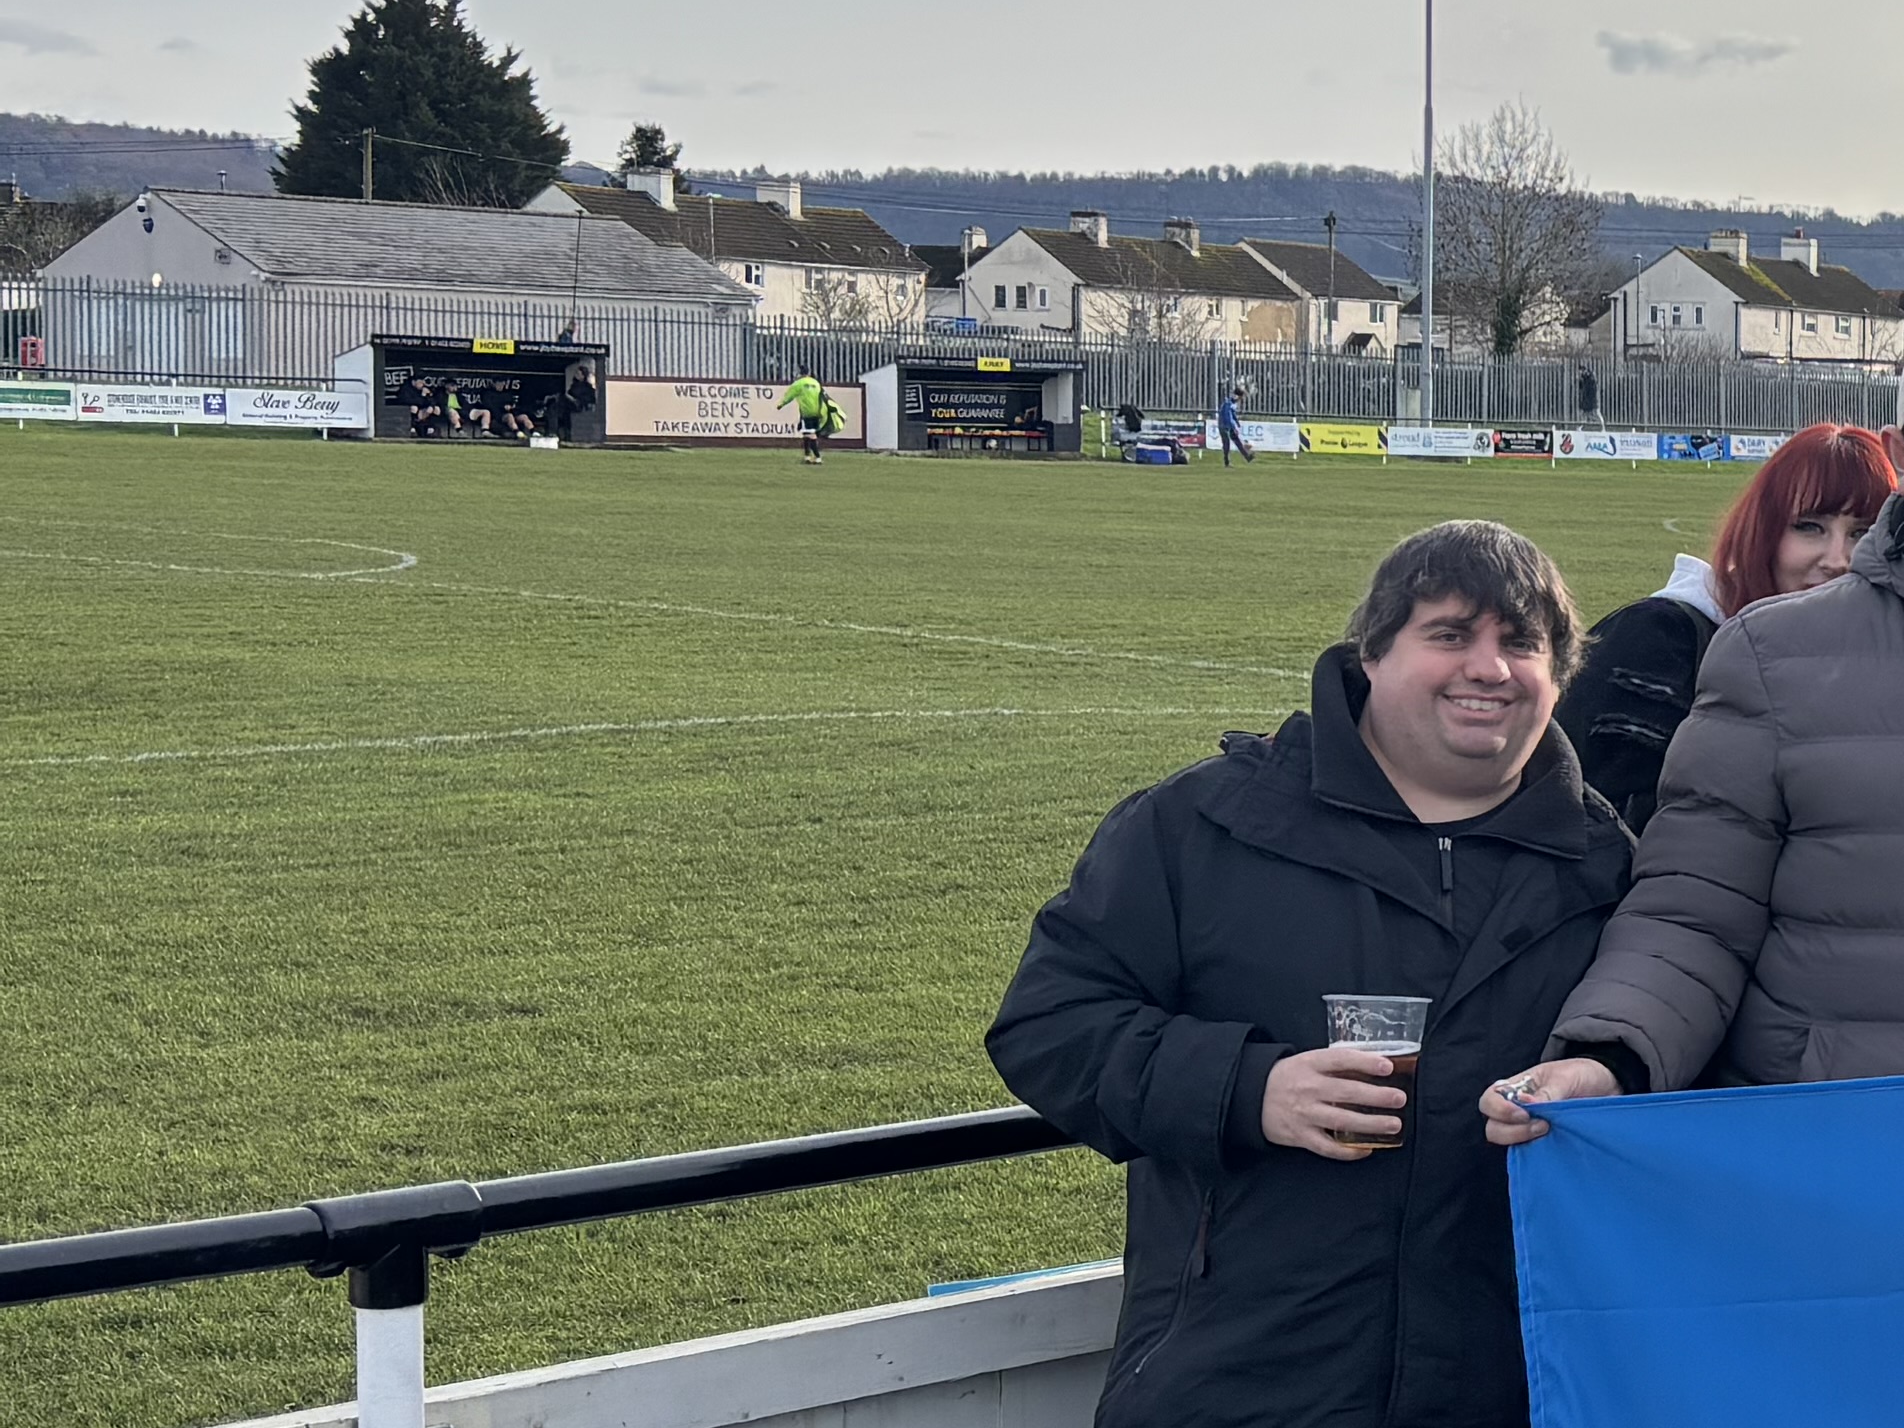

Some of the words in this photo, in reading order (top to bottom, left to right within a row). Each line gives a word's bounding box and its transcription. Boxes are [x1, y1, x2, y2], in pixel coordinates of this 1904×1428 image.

[675, 385, 750, 399] WELCOME
[755, 387, 774, 400] TO
[697, 401, 750, 419] BEN'S
[654, 420, 730, 434] TAKEAWAY
[734, 423, 796, 435] STADIUM
